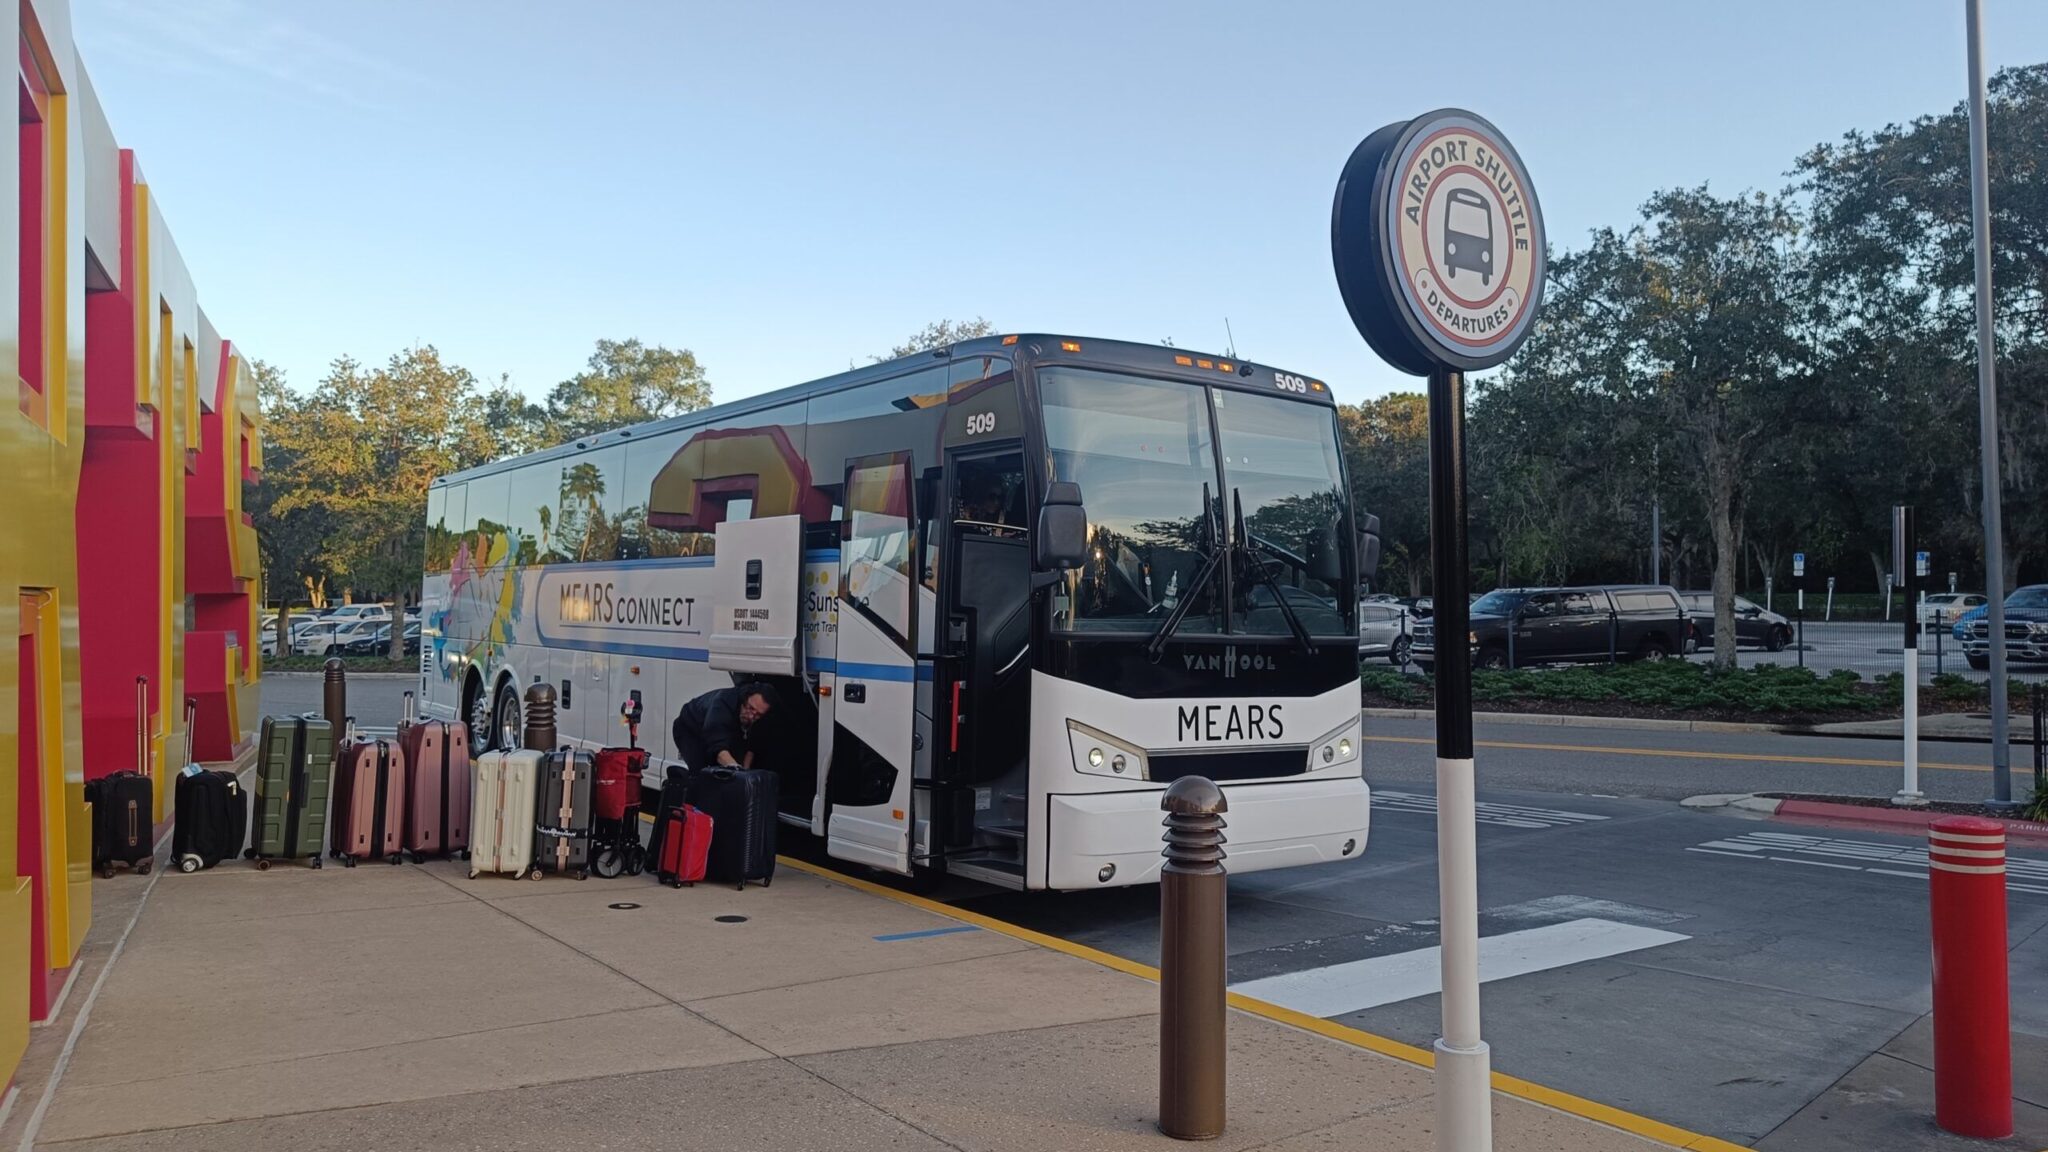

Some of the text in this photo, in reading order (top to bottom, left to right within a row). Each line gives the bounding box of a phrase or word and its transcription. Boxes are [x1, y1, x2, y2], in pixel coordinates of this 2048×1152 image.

[1405, 139, 1529, 252] AIRPORT SHUTTLE
[1426, 289, 1509, 334] DEPARTURES
[1274, 372, 1307, 394] 509
[966, 411, 996, 435] 509
[559, 582, 696, 627] MEARS CONNECT
[1178, 704, 1284, 742] MEARS
